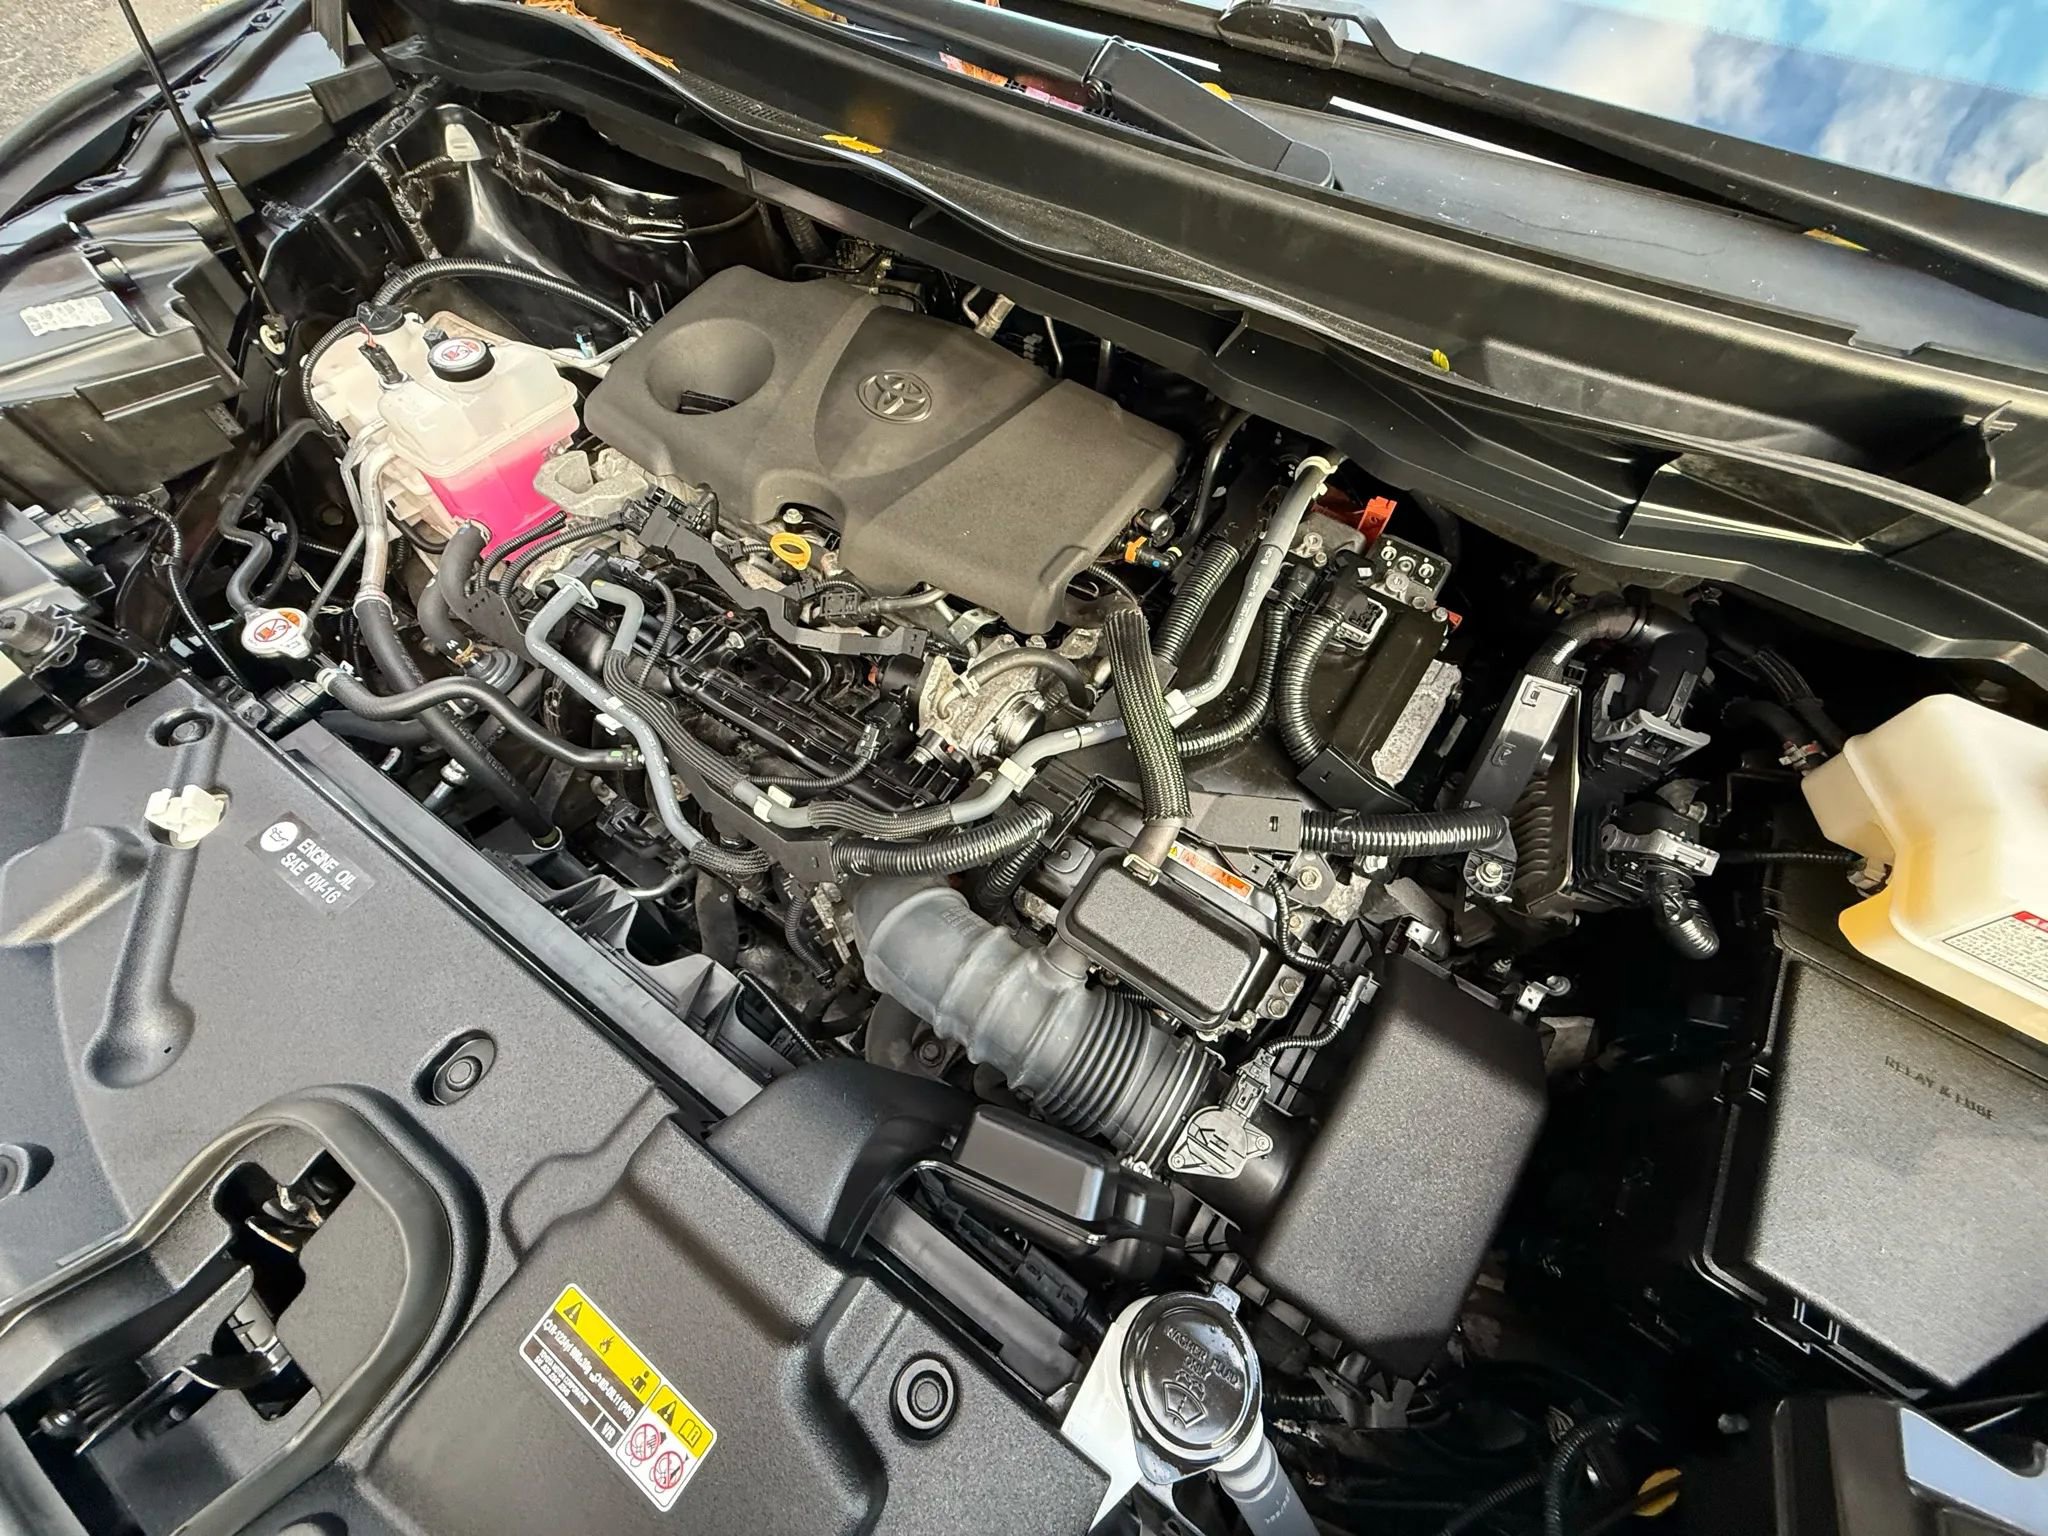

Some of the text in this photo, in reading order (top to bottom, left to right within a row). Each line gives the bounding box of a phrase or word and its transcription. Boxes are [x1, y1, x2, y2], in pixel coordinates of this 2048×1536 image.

[281, 852, 341, 904] SAE 0W-16
[297, 838, 357, 891] ENGINE OIL
[1885, 1055, 1935, 1088] RELAY
[1164, 1325, 1241, 1391] WASHER FLUID
[1184, 1355, 1212, 1381] ONLY
[601, 1422, 616, 1442] VR
